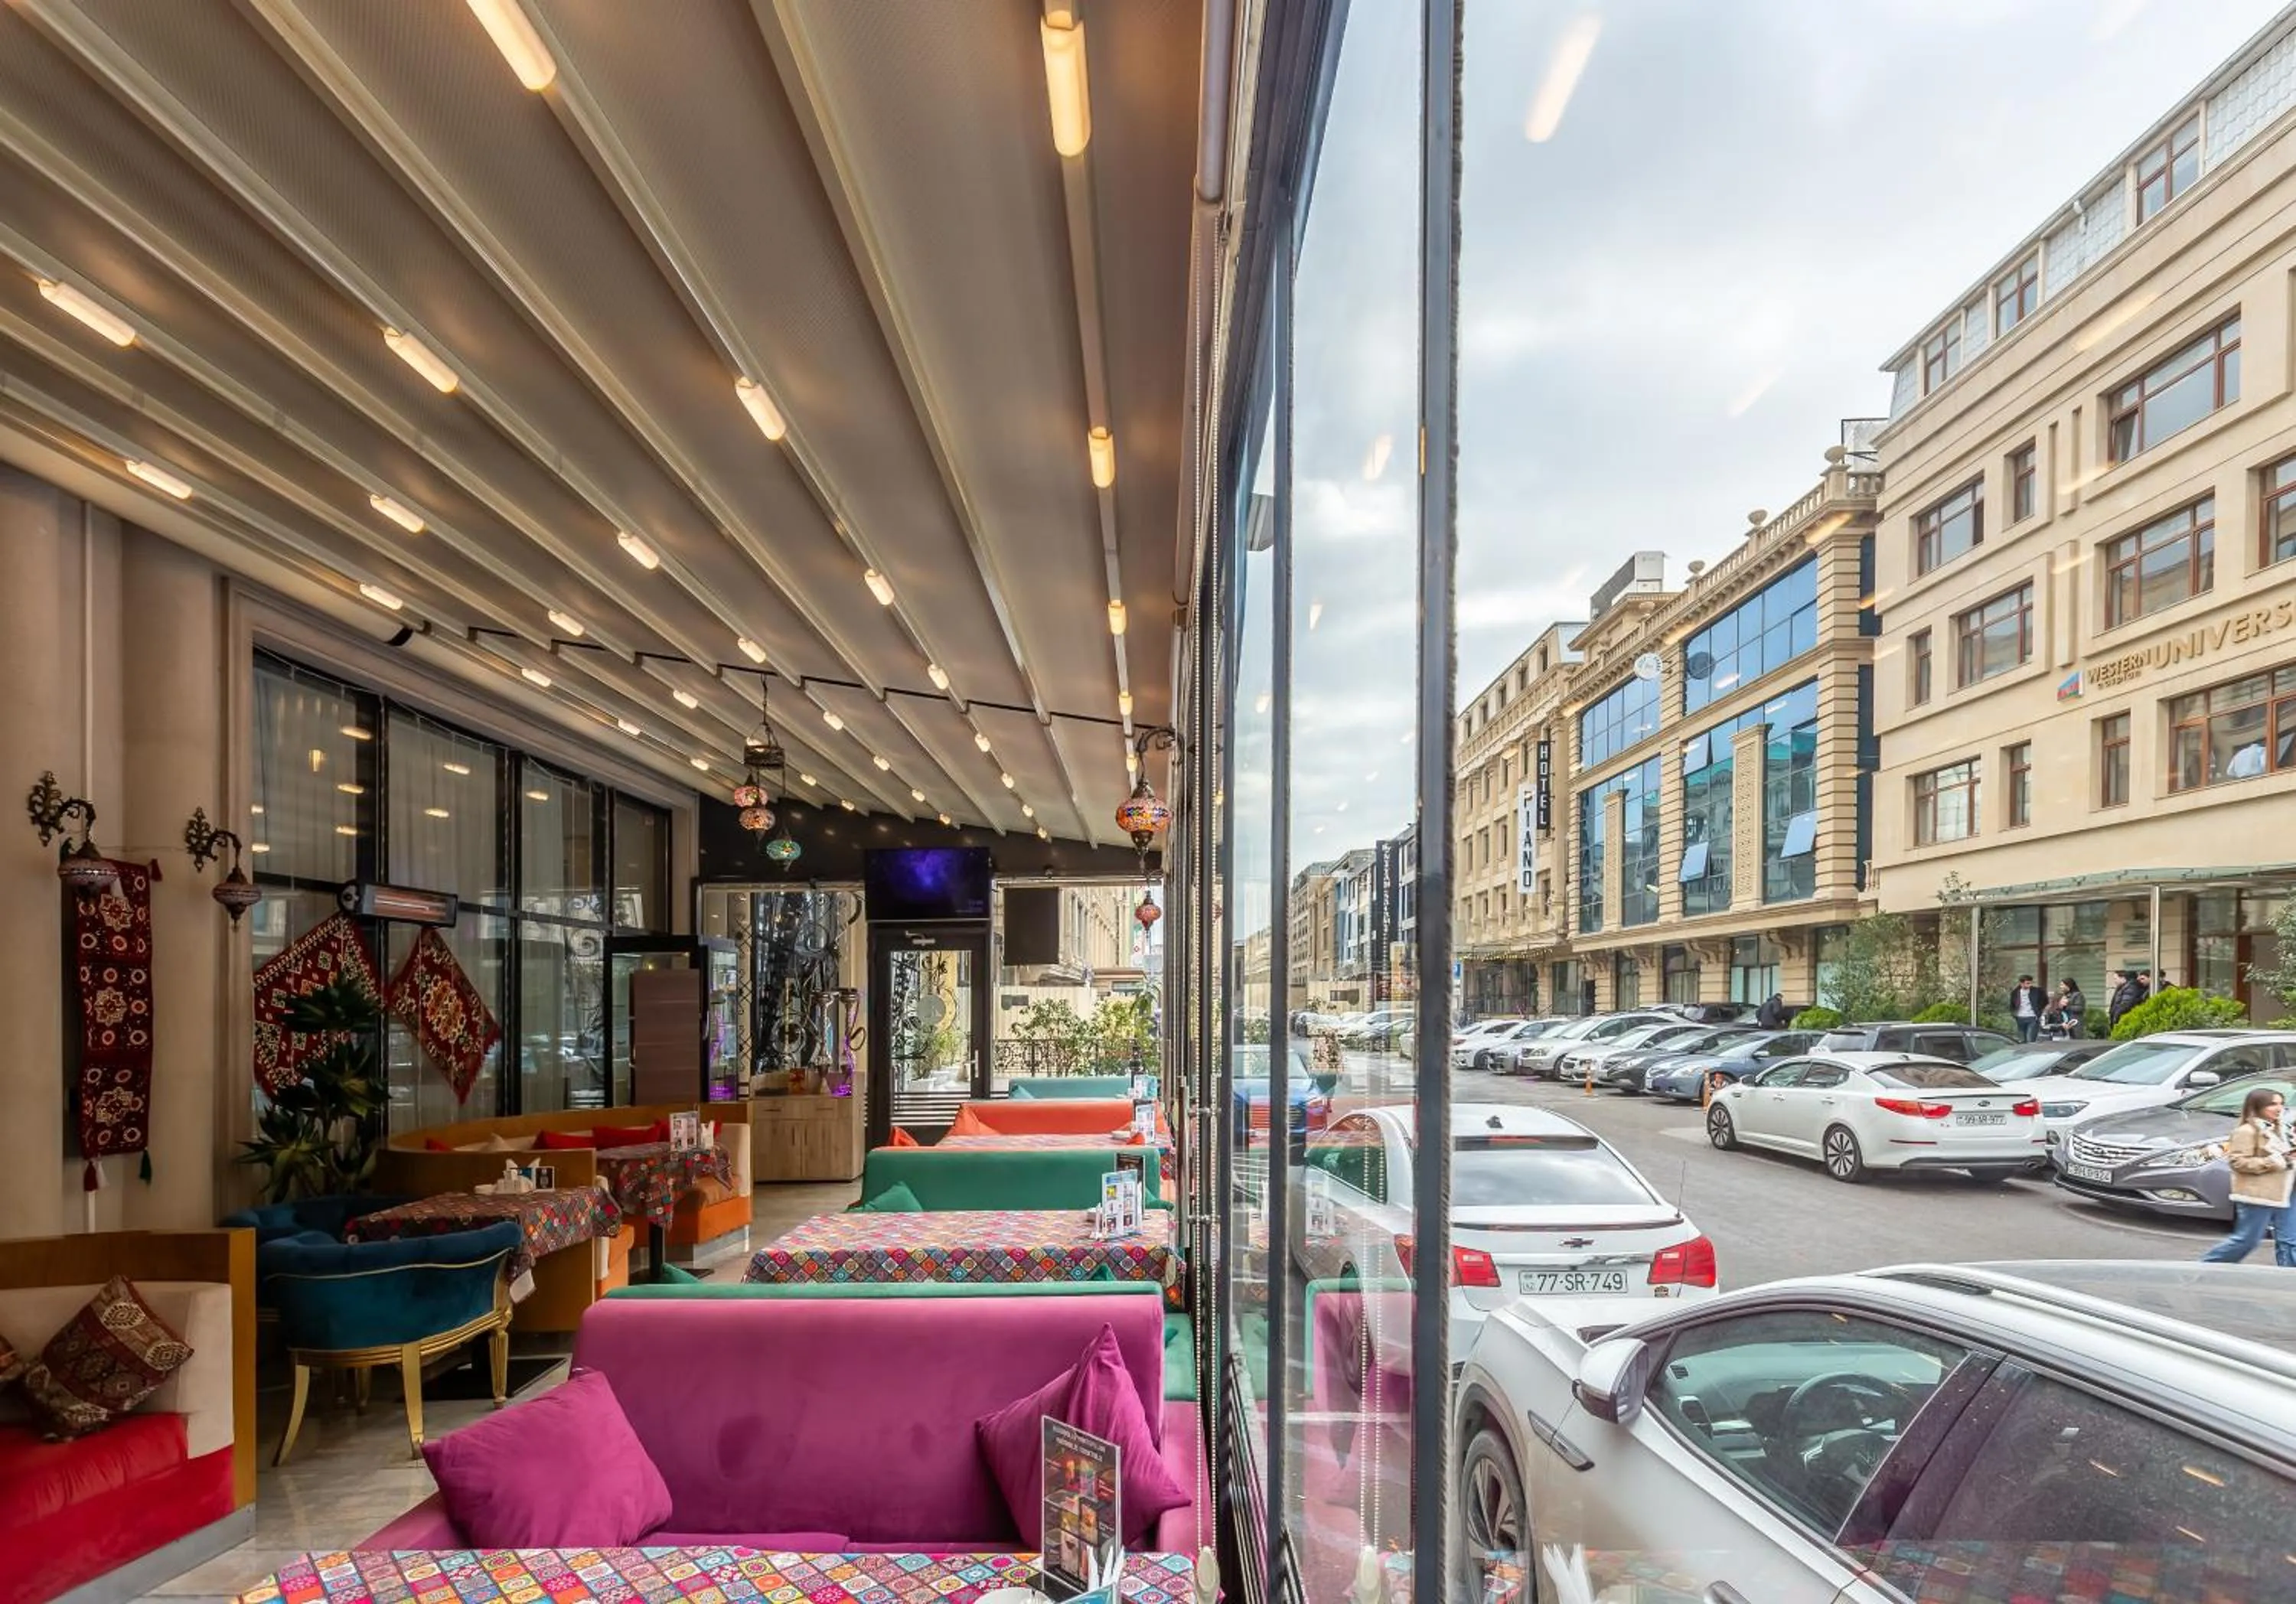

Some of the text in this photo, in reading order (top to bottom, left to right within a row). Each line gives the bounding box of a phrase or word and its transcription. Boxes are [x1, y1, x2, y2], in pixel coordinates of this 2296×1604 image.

[2086, 597, 2296, 685] WESTERN UNIVERS
[1540, 744, 1548, 825] HOTEL
[1523, 790, 1532, 887] PIANO
[1537, 1273, 1623, 1292] 77-SR-749
